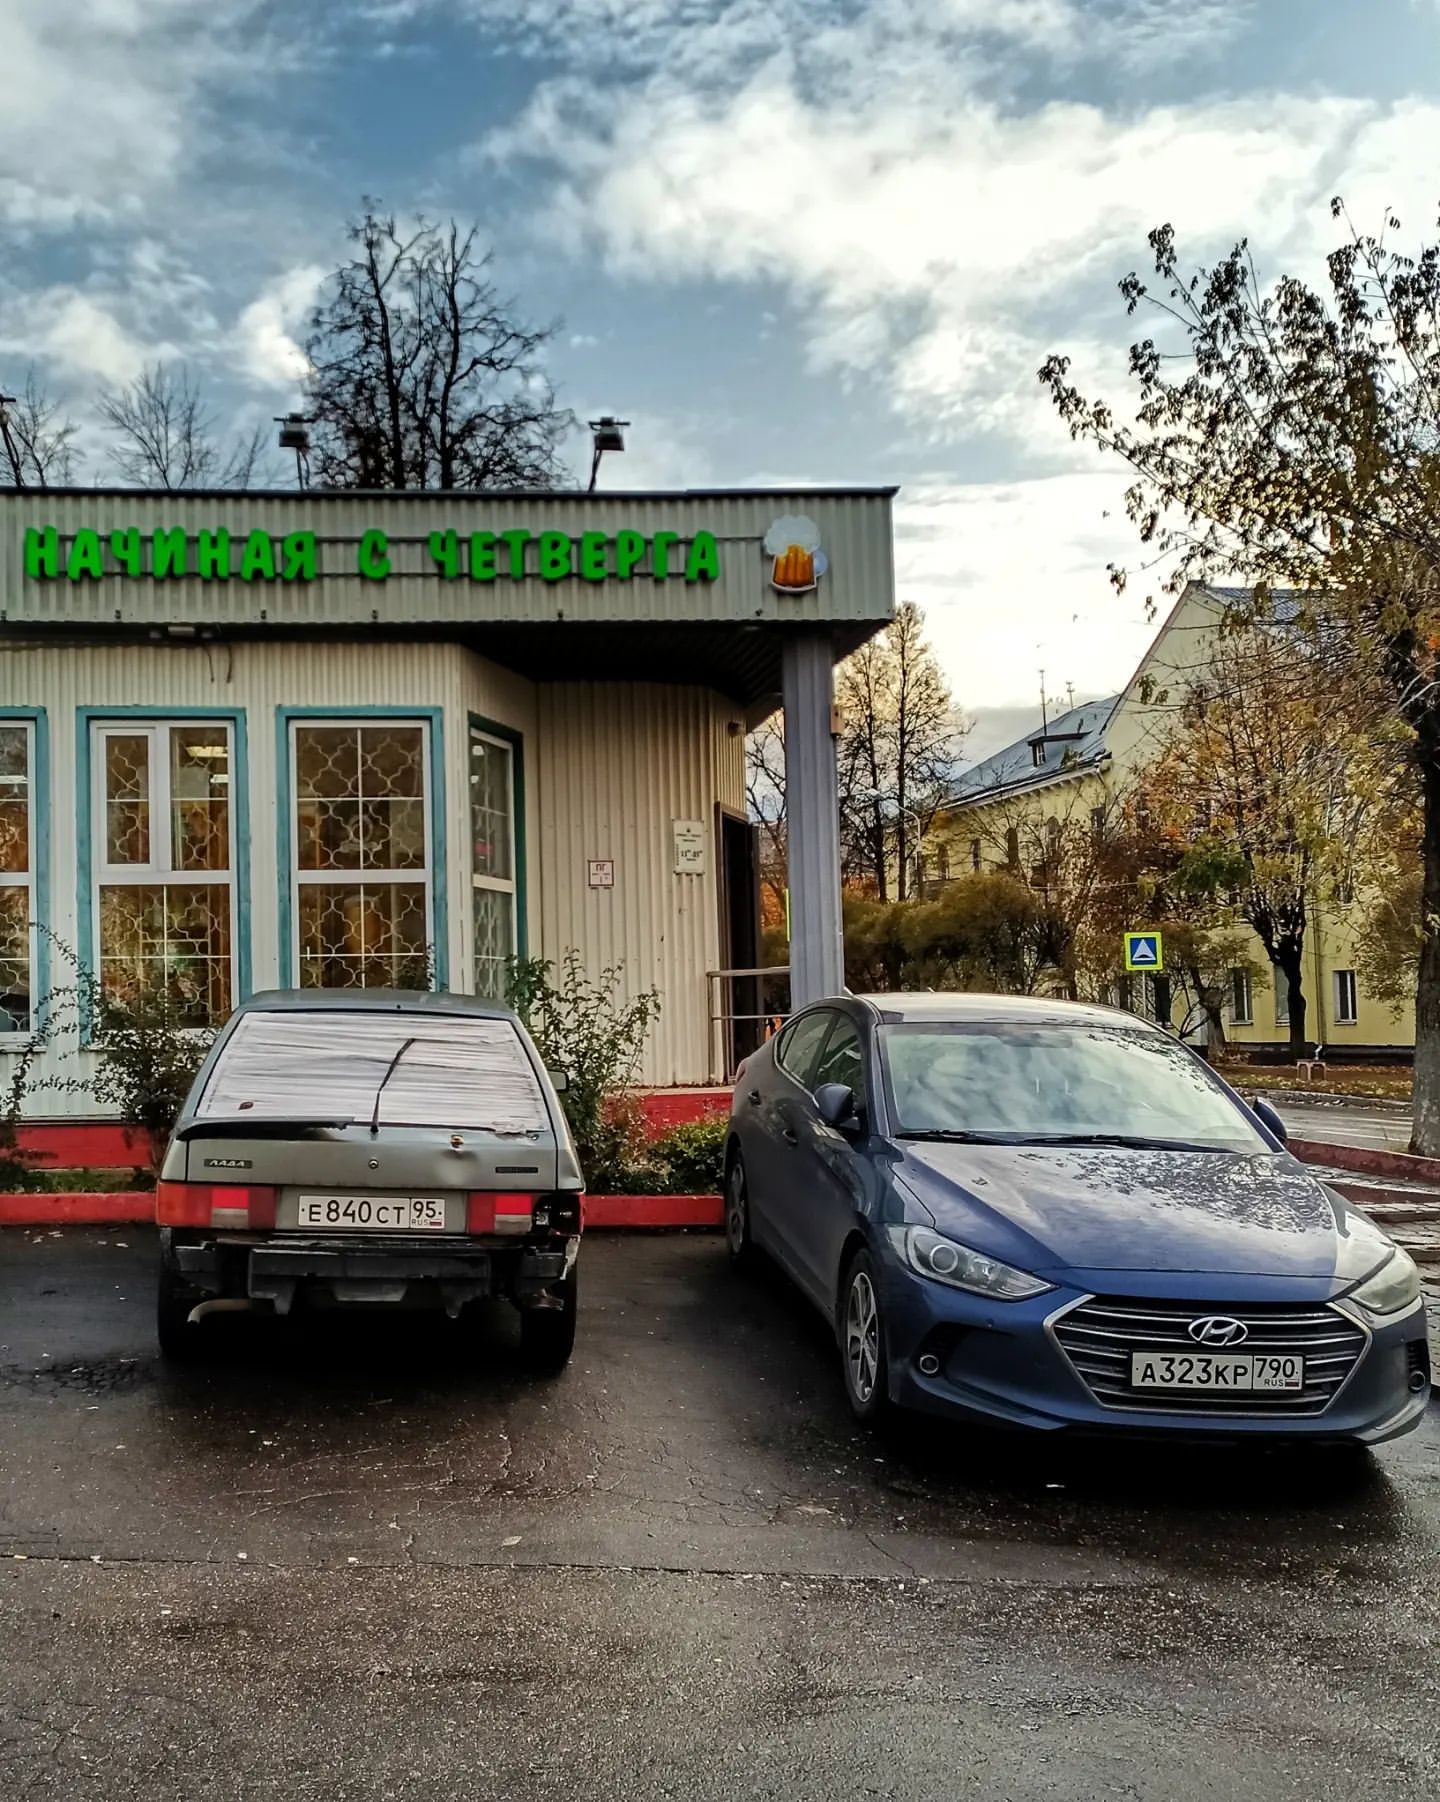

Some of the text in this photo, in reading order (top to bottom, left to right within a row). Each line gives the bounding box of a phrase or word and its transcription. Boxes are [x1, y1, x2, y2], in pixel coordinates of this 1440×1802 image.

[25, 526, 720, 582] НАЧИНАЯ С ЧЕТВЕРГА
[308, 1199, 436, 1225] Е840СТ 95
[1140, 1357, 1296, 1385] А323КР 790
[1264, 1378, 1284, 1387] RUS
